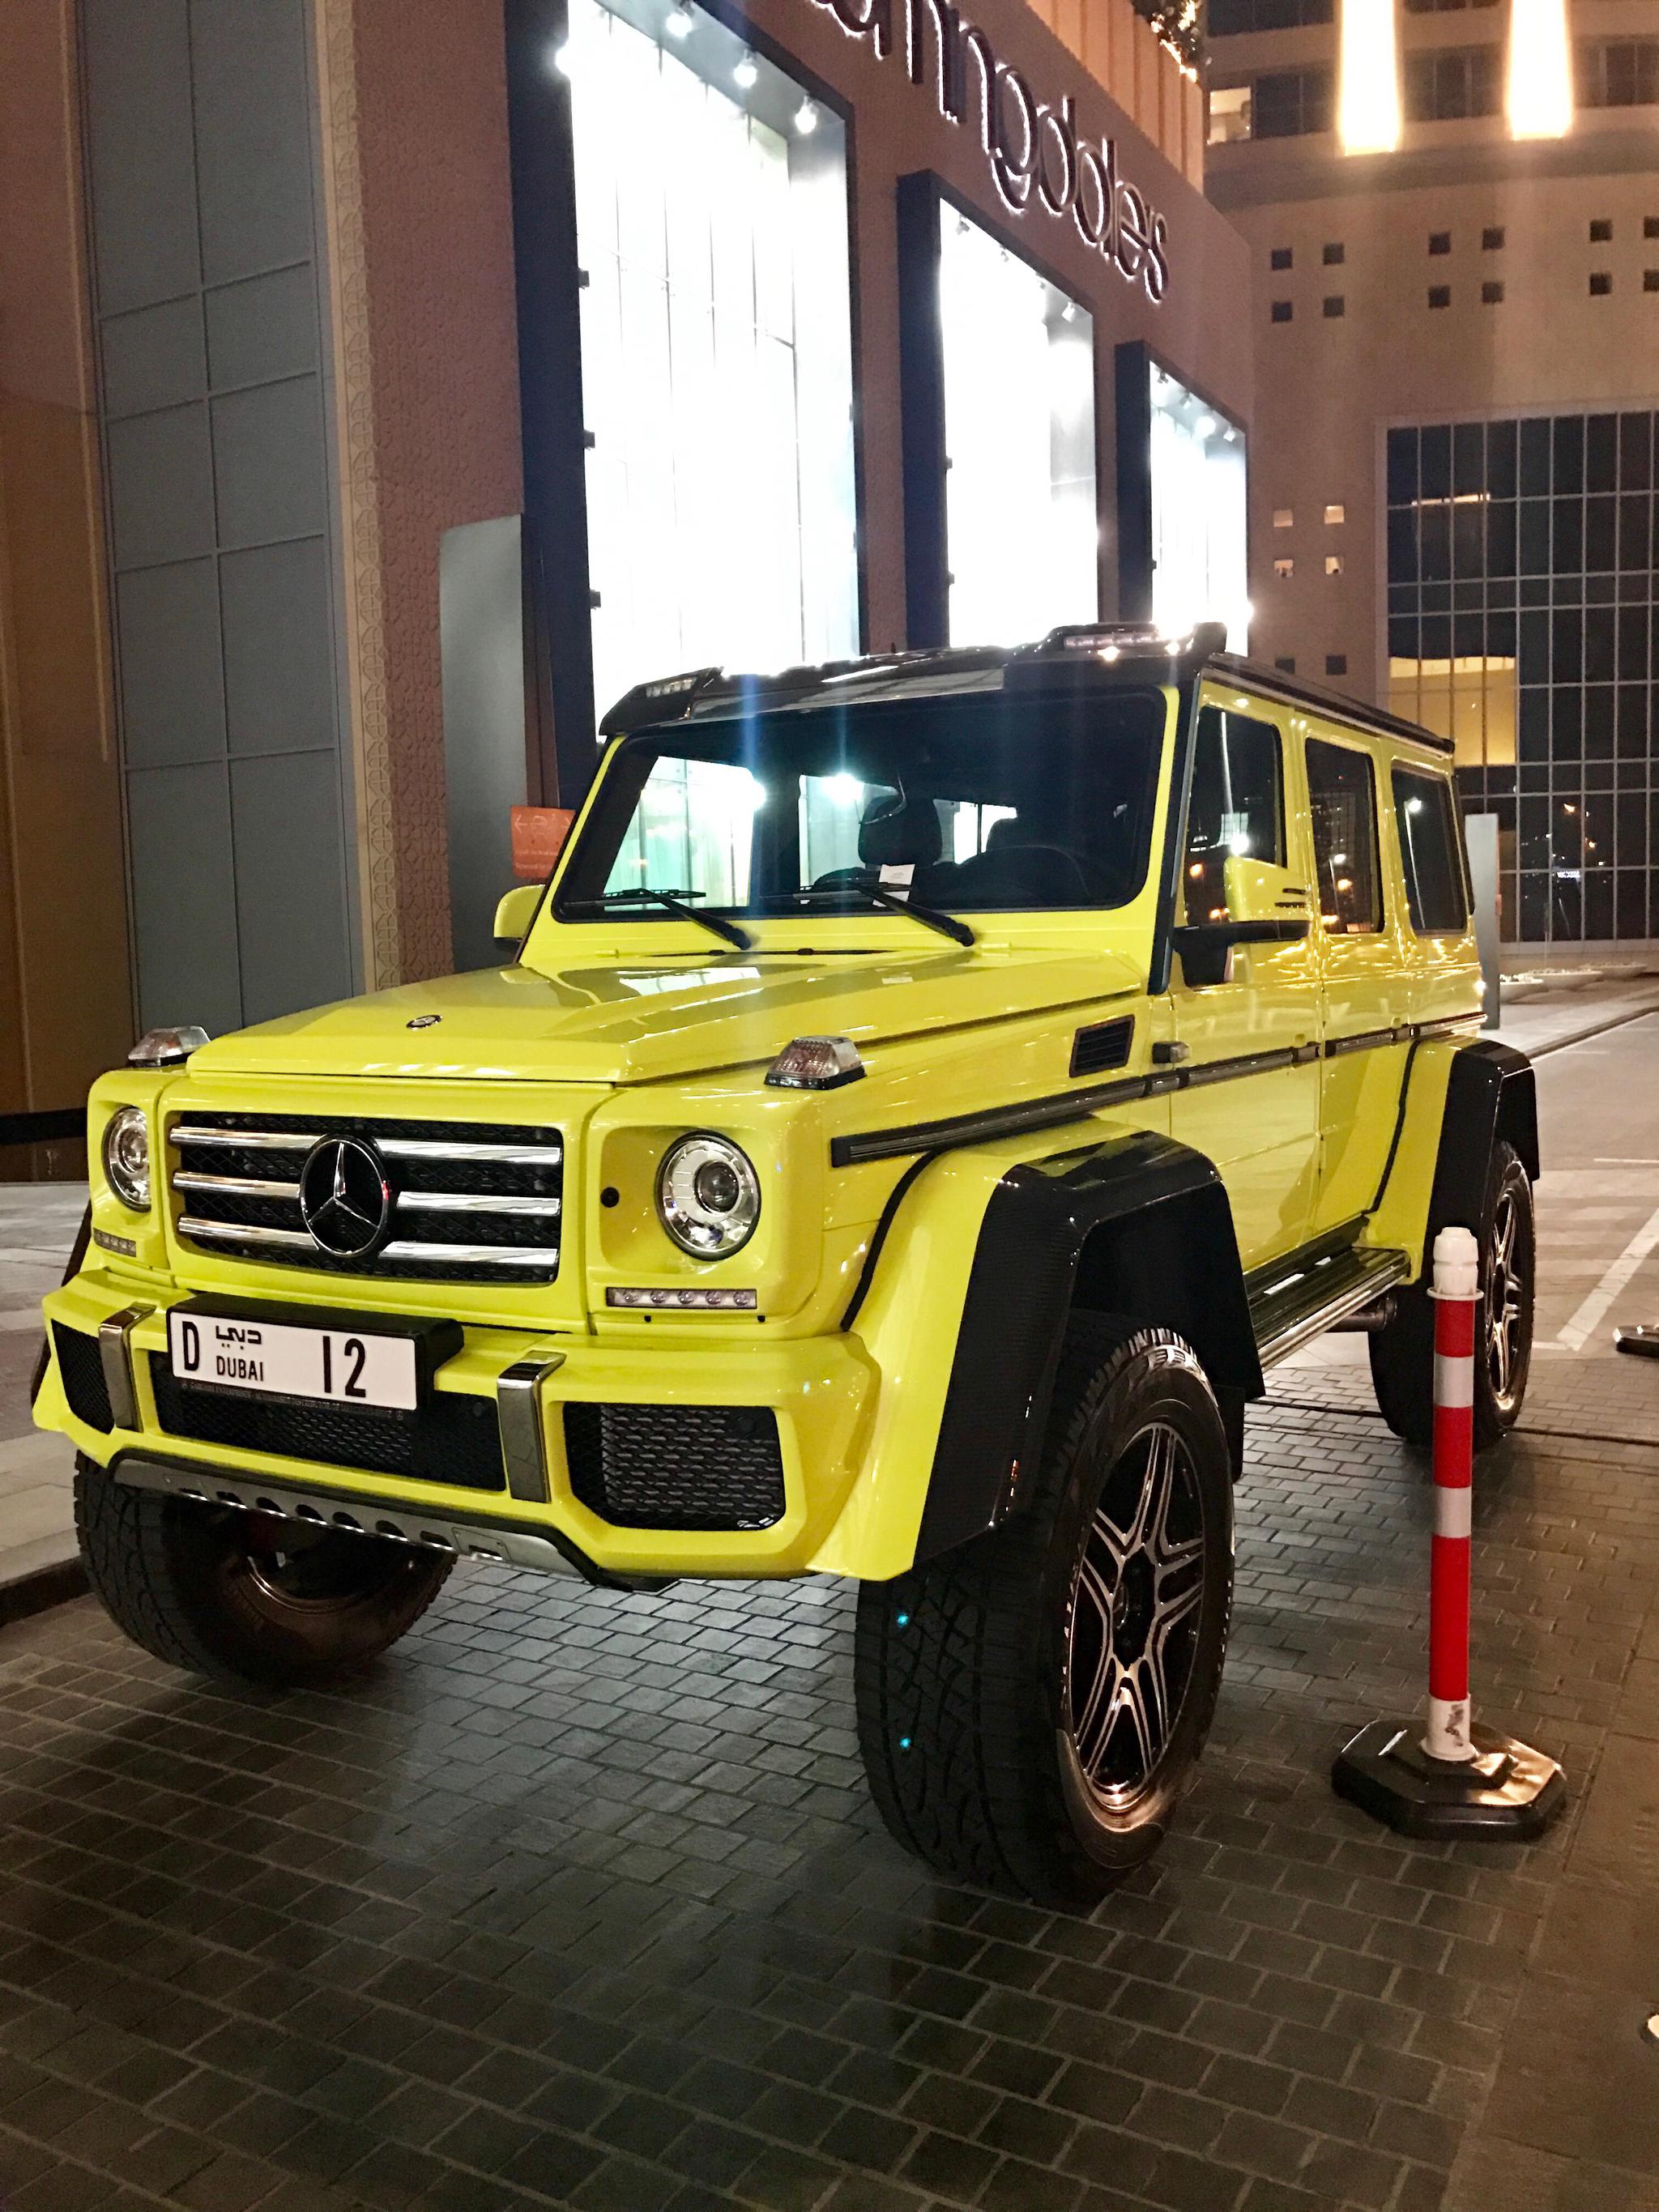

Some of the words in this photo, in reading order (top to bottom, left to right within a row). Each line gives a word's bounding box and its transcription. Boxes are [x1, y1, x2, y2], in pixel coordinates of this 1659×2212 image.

[182, 1321, 199, 1370] D
[215, 1326, 262, 1350] دبي
[216, 1356, 263, 1381] DUBAI
[322, 1336, 366, 1397] 12
